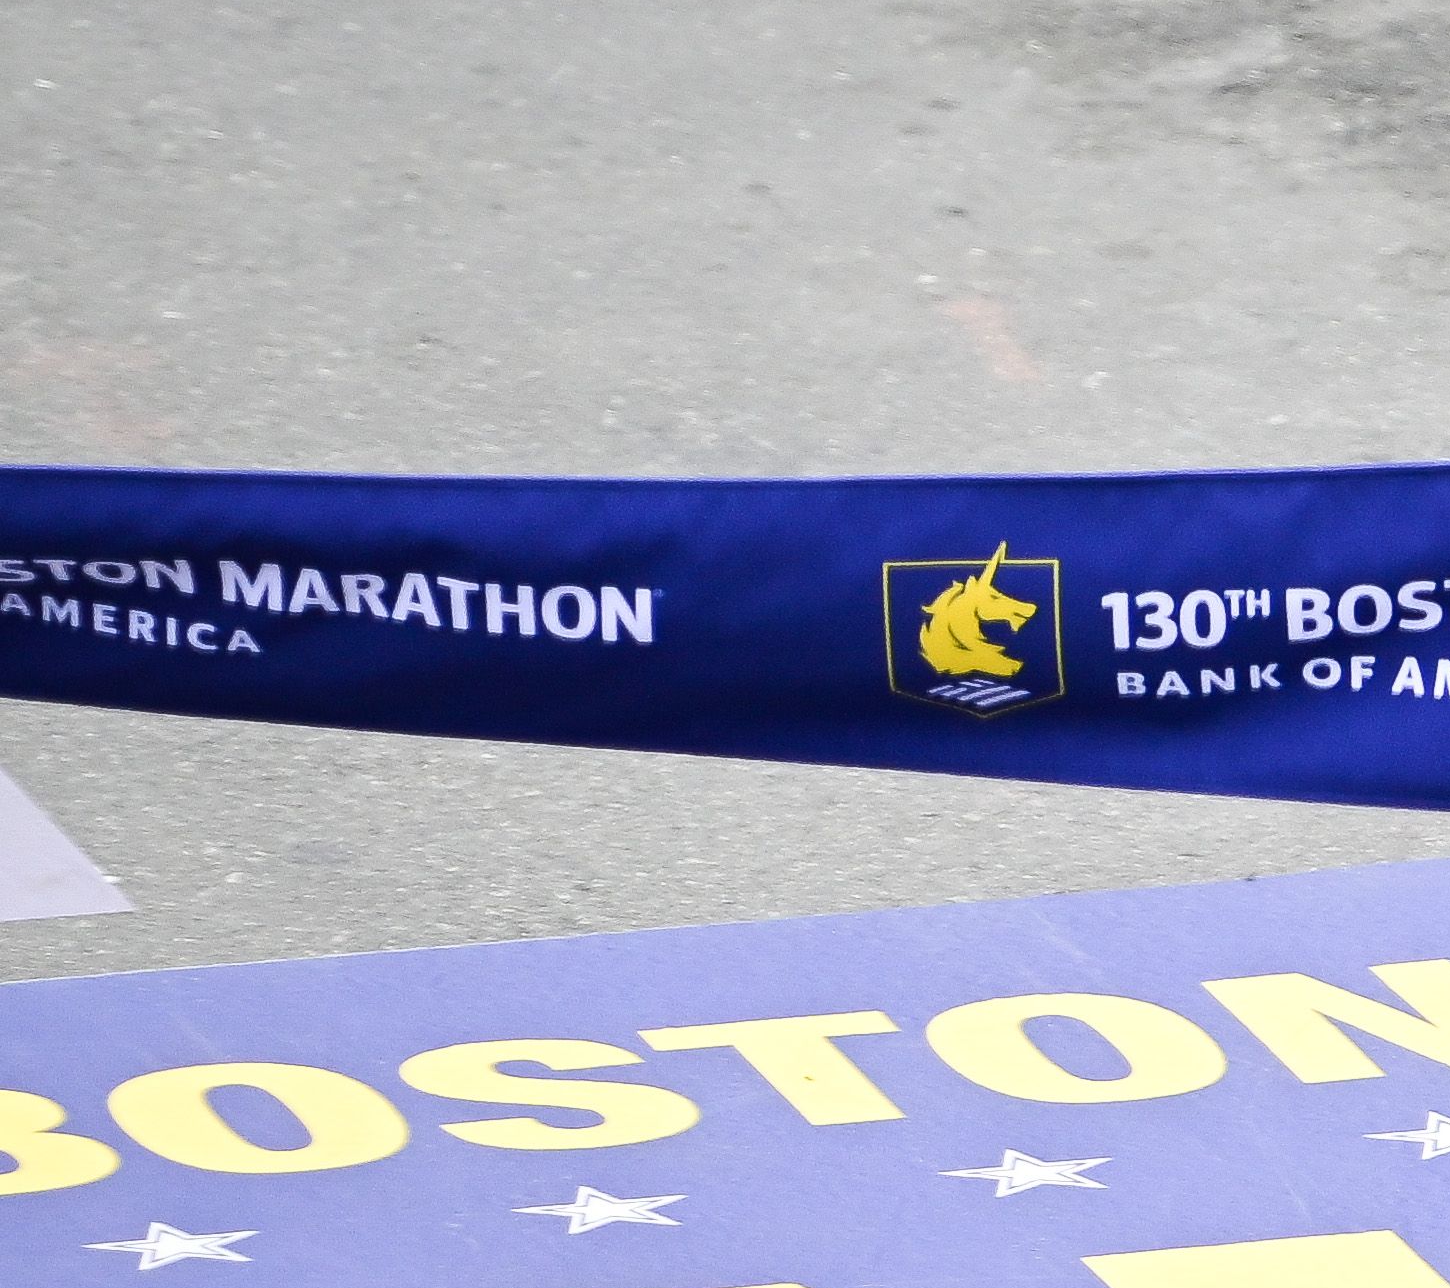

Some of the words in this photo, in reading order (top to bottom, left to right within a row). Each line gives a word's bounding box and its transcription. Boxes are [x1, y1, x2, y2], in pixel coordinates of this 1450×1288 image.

[0, 558, 194, 595] STON
[218, 559, 653, 643] MARATHON
[0, 593, 261, 653] AMERICA
[1101, 588, 1271, 651] 130TH
[1117, 663, 1280, 698] BANK
[1301, 656, 1374, 693] OF
